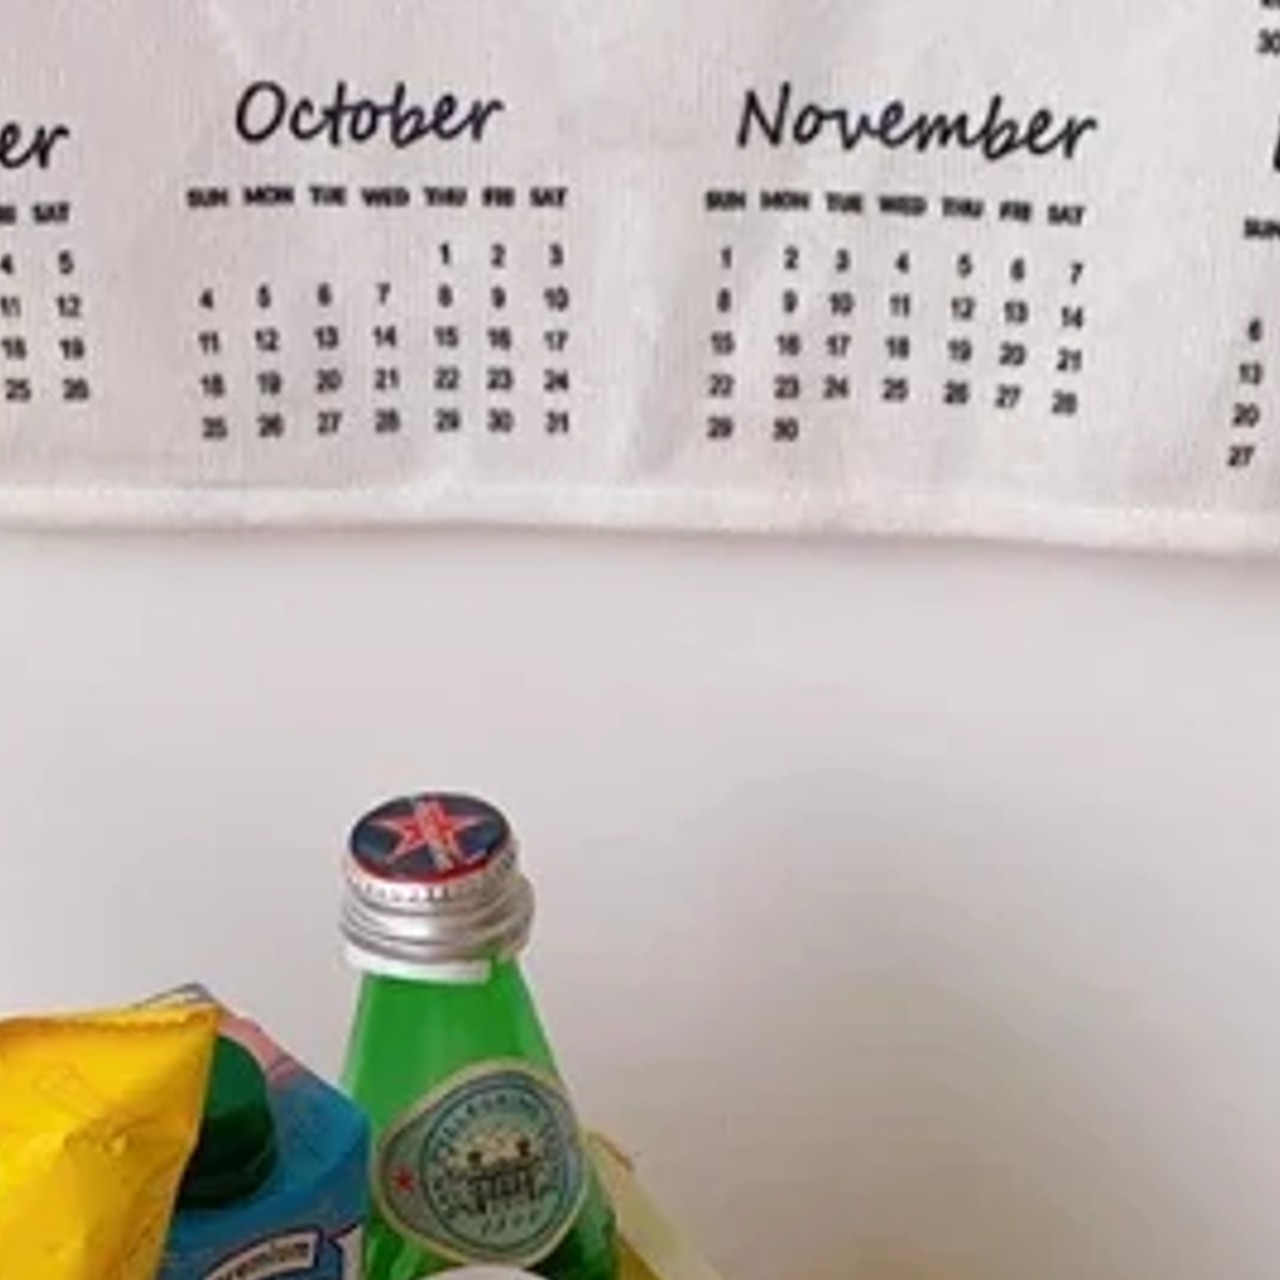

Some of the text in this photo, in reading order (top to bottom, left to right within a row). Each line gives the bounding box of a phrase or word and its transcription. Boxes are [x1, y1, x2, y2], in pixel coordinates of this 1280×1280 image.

[235, 80, 505, 150] October
[736, 81, 1098, 163] November
[185, 184, 568, 209] SUN MON TUE WED THU FRI SAT
[30, 201, 70, 225] SAT
[941, 196, 985, 220] THU
[998, 200, 1033, 224] FRI
[1047, 203, 1086, 226] SAT
[57, 249, 75, 276] 5
[439, 242, 564, 269] 1 2 3
[720, 244, 1084, 286] 1 2 3 4 5 6 7
[55, 293, 82, 319] 12
[199, 289, 214, 310] 4
[257, 283, 272, 310] 5
[317, 282, 333, 307] 6
[376, 281, 392, 305] 7
[543, 285, 570, 313] 10
[783, 289, 799, 314] 9
[828, 291, 856, 317] 10
[889, 293, 911, 318] 11
[950, 296, 977, 322] 12
[1003, 300, 1030, 325] 13
[1061, 306, 1084, 330] 14
[197, 325, 569, 355] 11 12 13 14 15 16 17
[1247, 317, 1263, 343] 6
[58, 336, 86, 360] 19
[709, 330, 736, 356] 15
[776, 333, 802, 357] 16
[825, 333, 852, 357] 17
[885, 335, 911, 360] 18
[947, 338, 973, 364] 19
[998, 341, 1027, 367] 20
[315, 368, 343, 395] 20
[373, 367, 400, 392] 21
[433, 365, 461, 392] 22
[1238, 361, 1264, 387] 13
[822, 374, 850, 400] 24
[994, 383, 1022, 409] 27
[316, 410, 343, 436] 27
[545, 409, 570, 435] 31
[1231, 402, 1261, 428] 20
[772, 417, 800, 442] 30
[1226, 444, 1256, 468] 27
